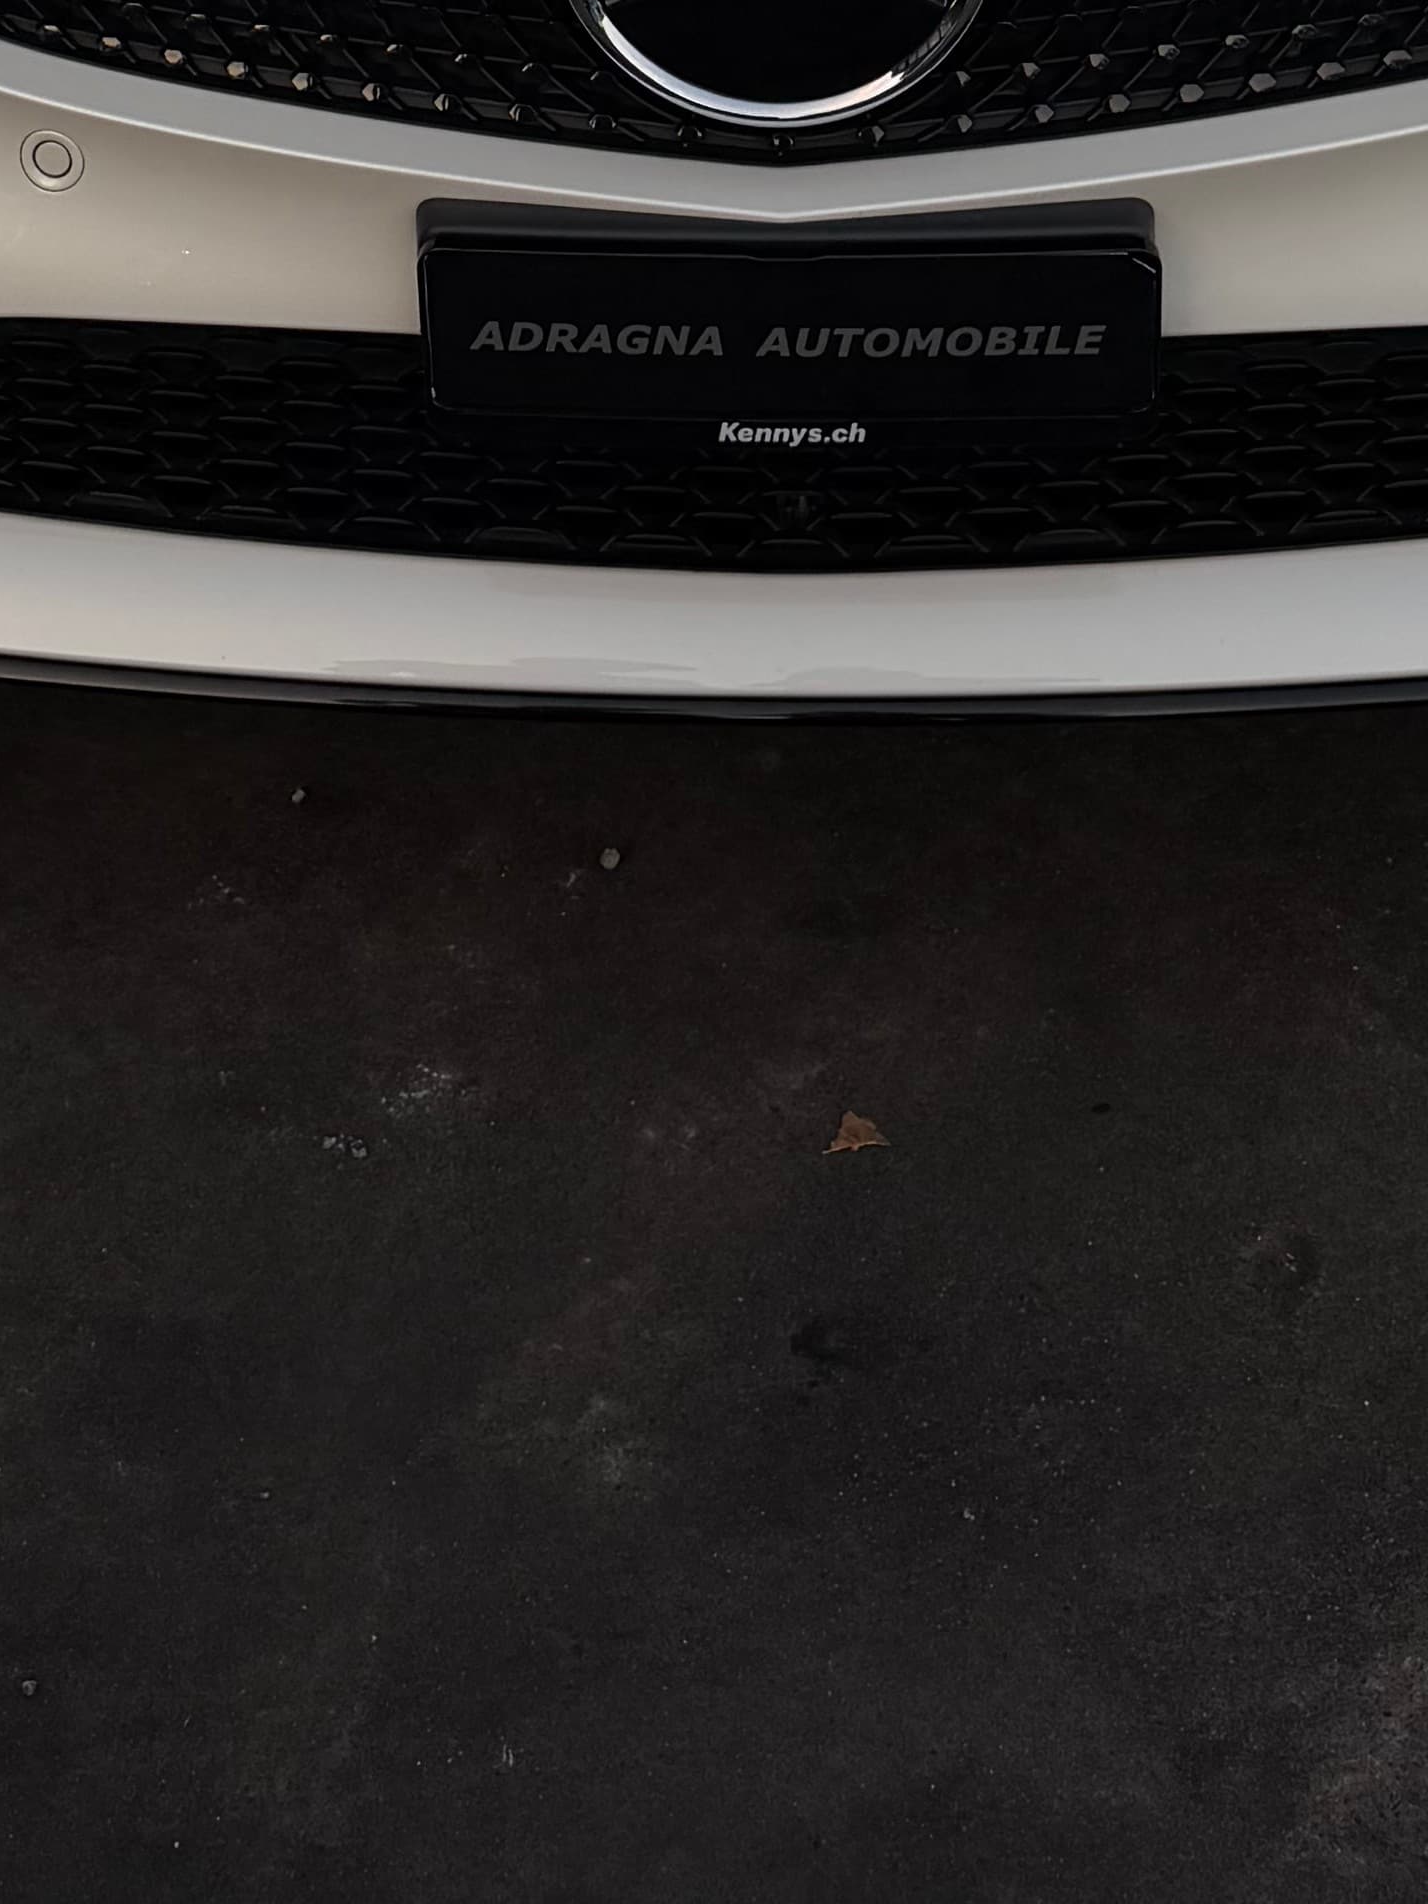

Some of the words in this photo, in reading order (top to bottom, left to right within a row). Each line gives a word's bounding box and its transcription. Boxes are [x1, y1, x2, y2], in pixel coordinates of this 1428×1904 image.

[470, 320, 725, 357] ADRAGNA
[756, 324, 1107, 359] AUTOMOBILE
[718, 420, 866, 448] Kennys.ch
